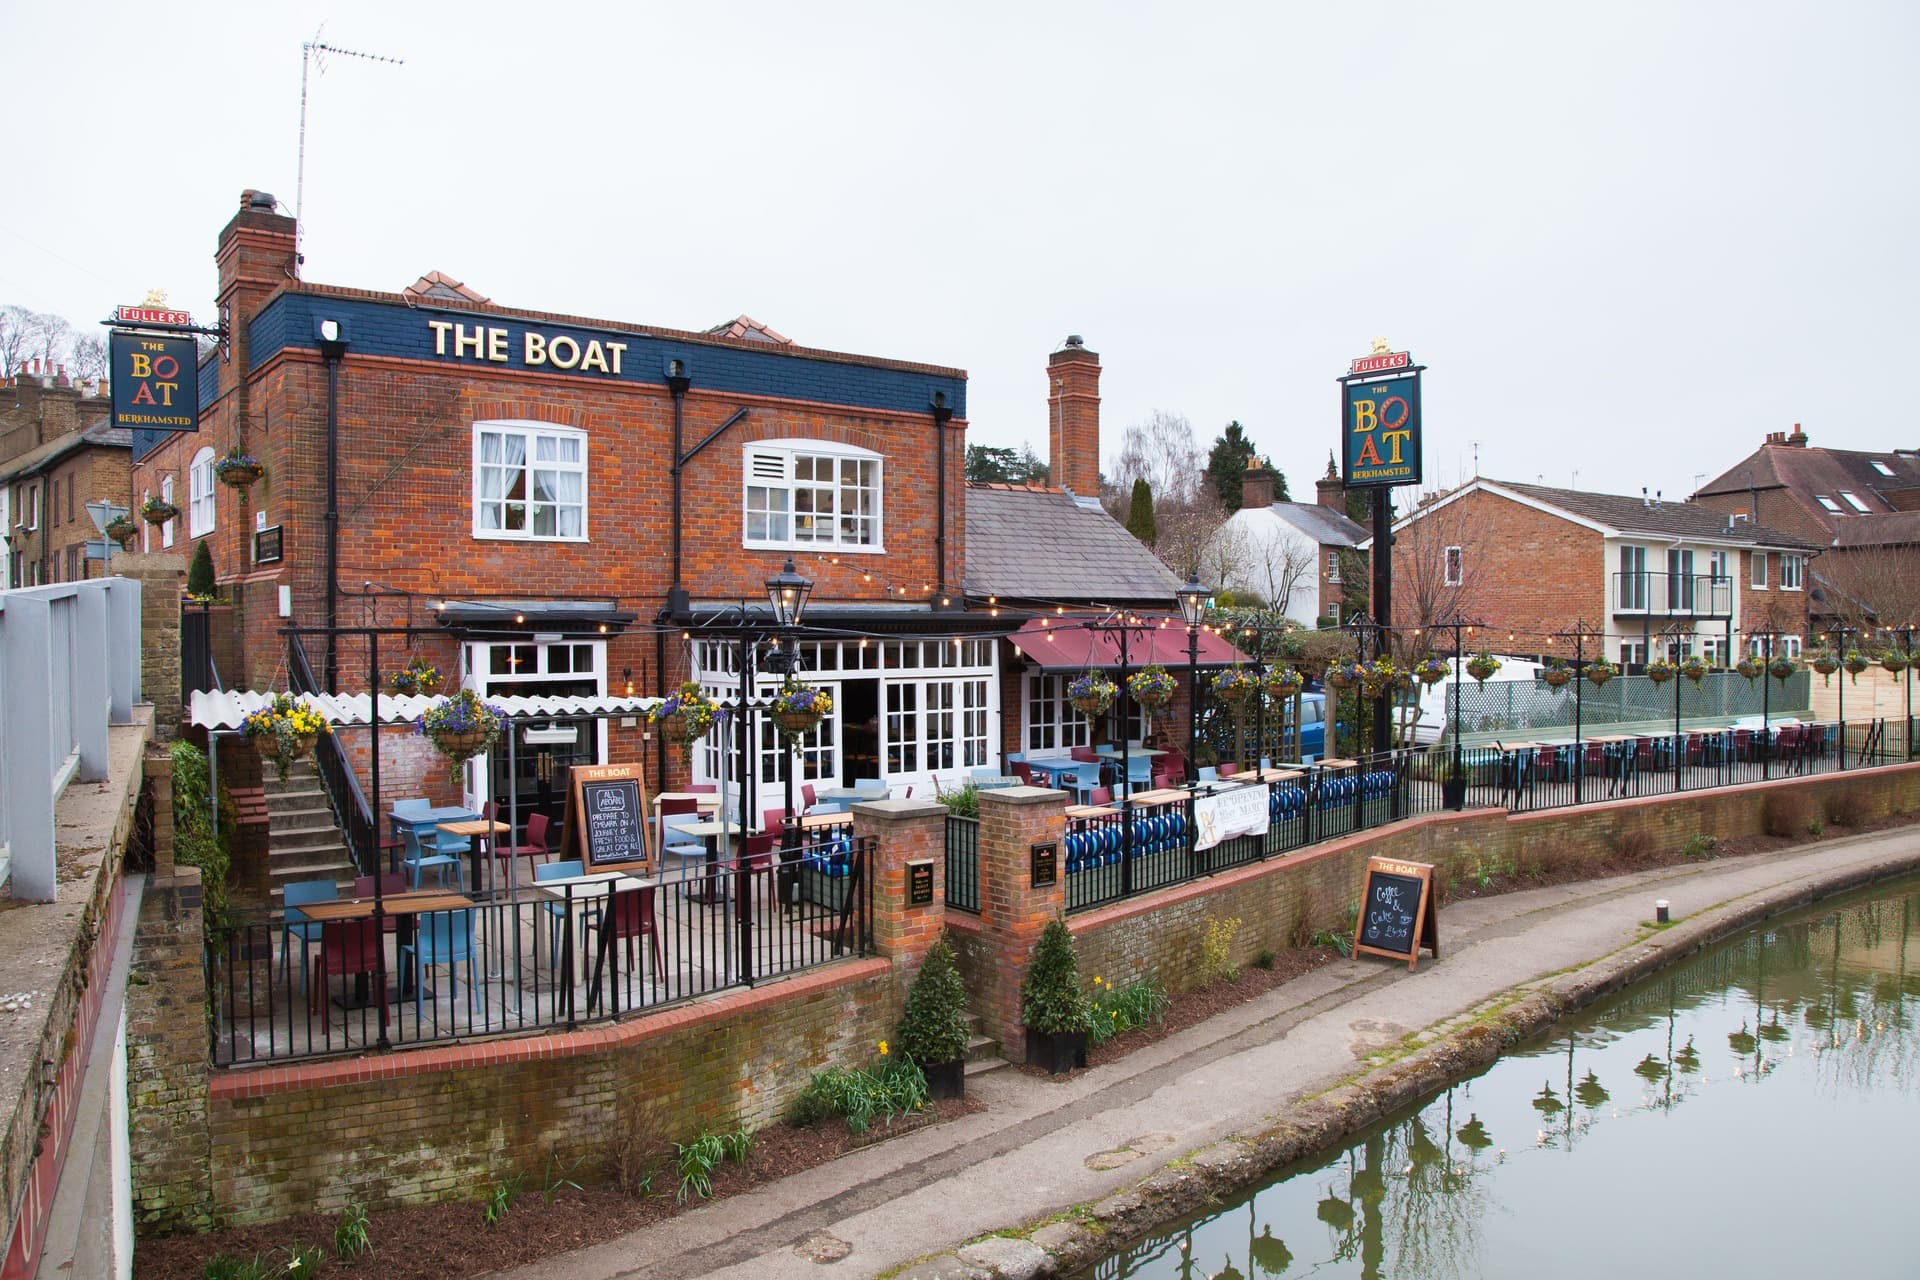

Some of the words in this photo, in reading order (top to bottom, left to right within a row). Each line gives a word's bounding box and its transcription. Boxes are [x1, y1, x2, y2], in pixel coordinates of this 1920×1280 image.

[122, 307, 186, 323] FULLER'S
[141, 341, 165, 351] THE
[428, 320, 508, 361] THE
[524, 332, 627, 374] BOAT
[1354, 355, 1404, 372] FULLER'S
[1371, 385, 1388, 394] THE
[118, 413, 191, 425] BERKHAMSTED
[1352, 467, 1410, 479] BERKHAMSTED
[589, 770, 605, 778] THE
[608, 768, 630, 776] BOAT
[593, 812, 618, 820] PREPARE
[621, 811, 630, 819] TO
[593, 821, 618, 830] EMBARK
[594, 829, 618, 838] JOURNEY
[620, 827, 628, 835] OF
[595, 837, 613, 846] FRESH
[614, 836, 631, 844] FOOD
[595, 845, 614, 854] GREAT
[630, 842, 639, 850] ALE
[1379, 862, 1394, 872] THE
[1395, 865, 1418, 875] BOAT
[1376, 886, 1405, 905] Coffee
[1392, 900, 1404, 913] &
[1371, 911, 1393, 924] Cake
